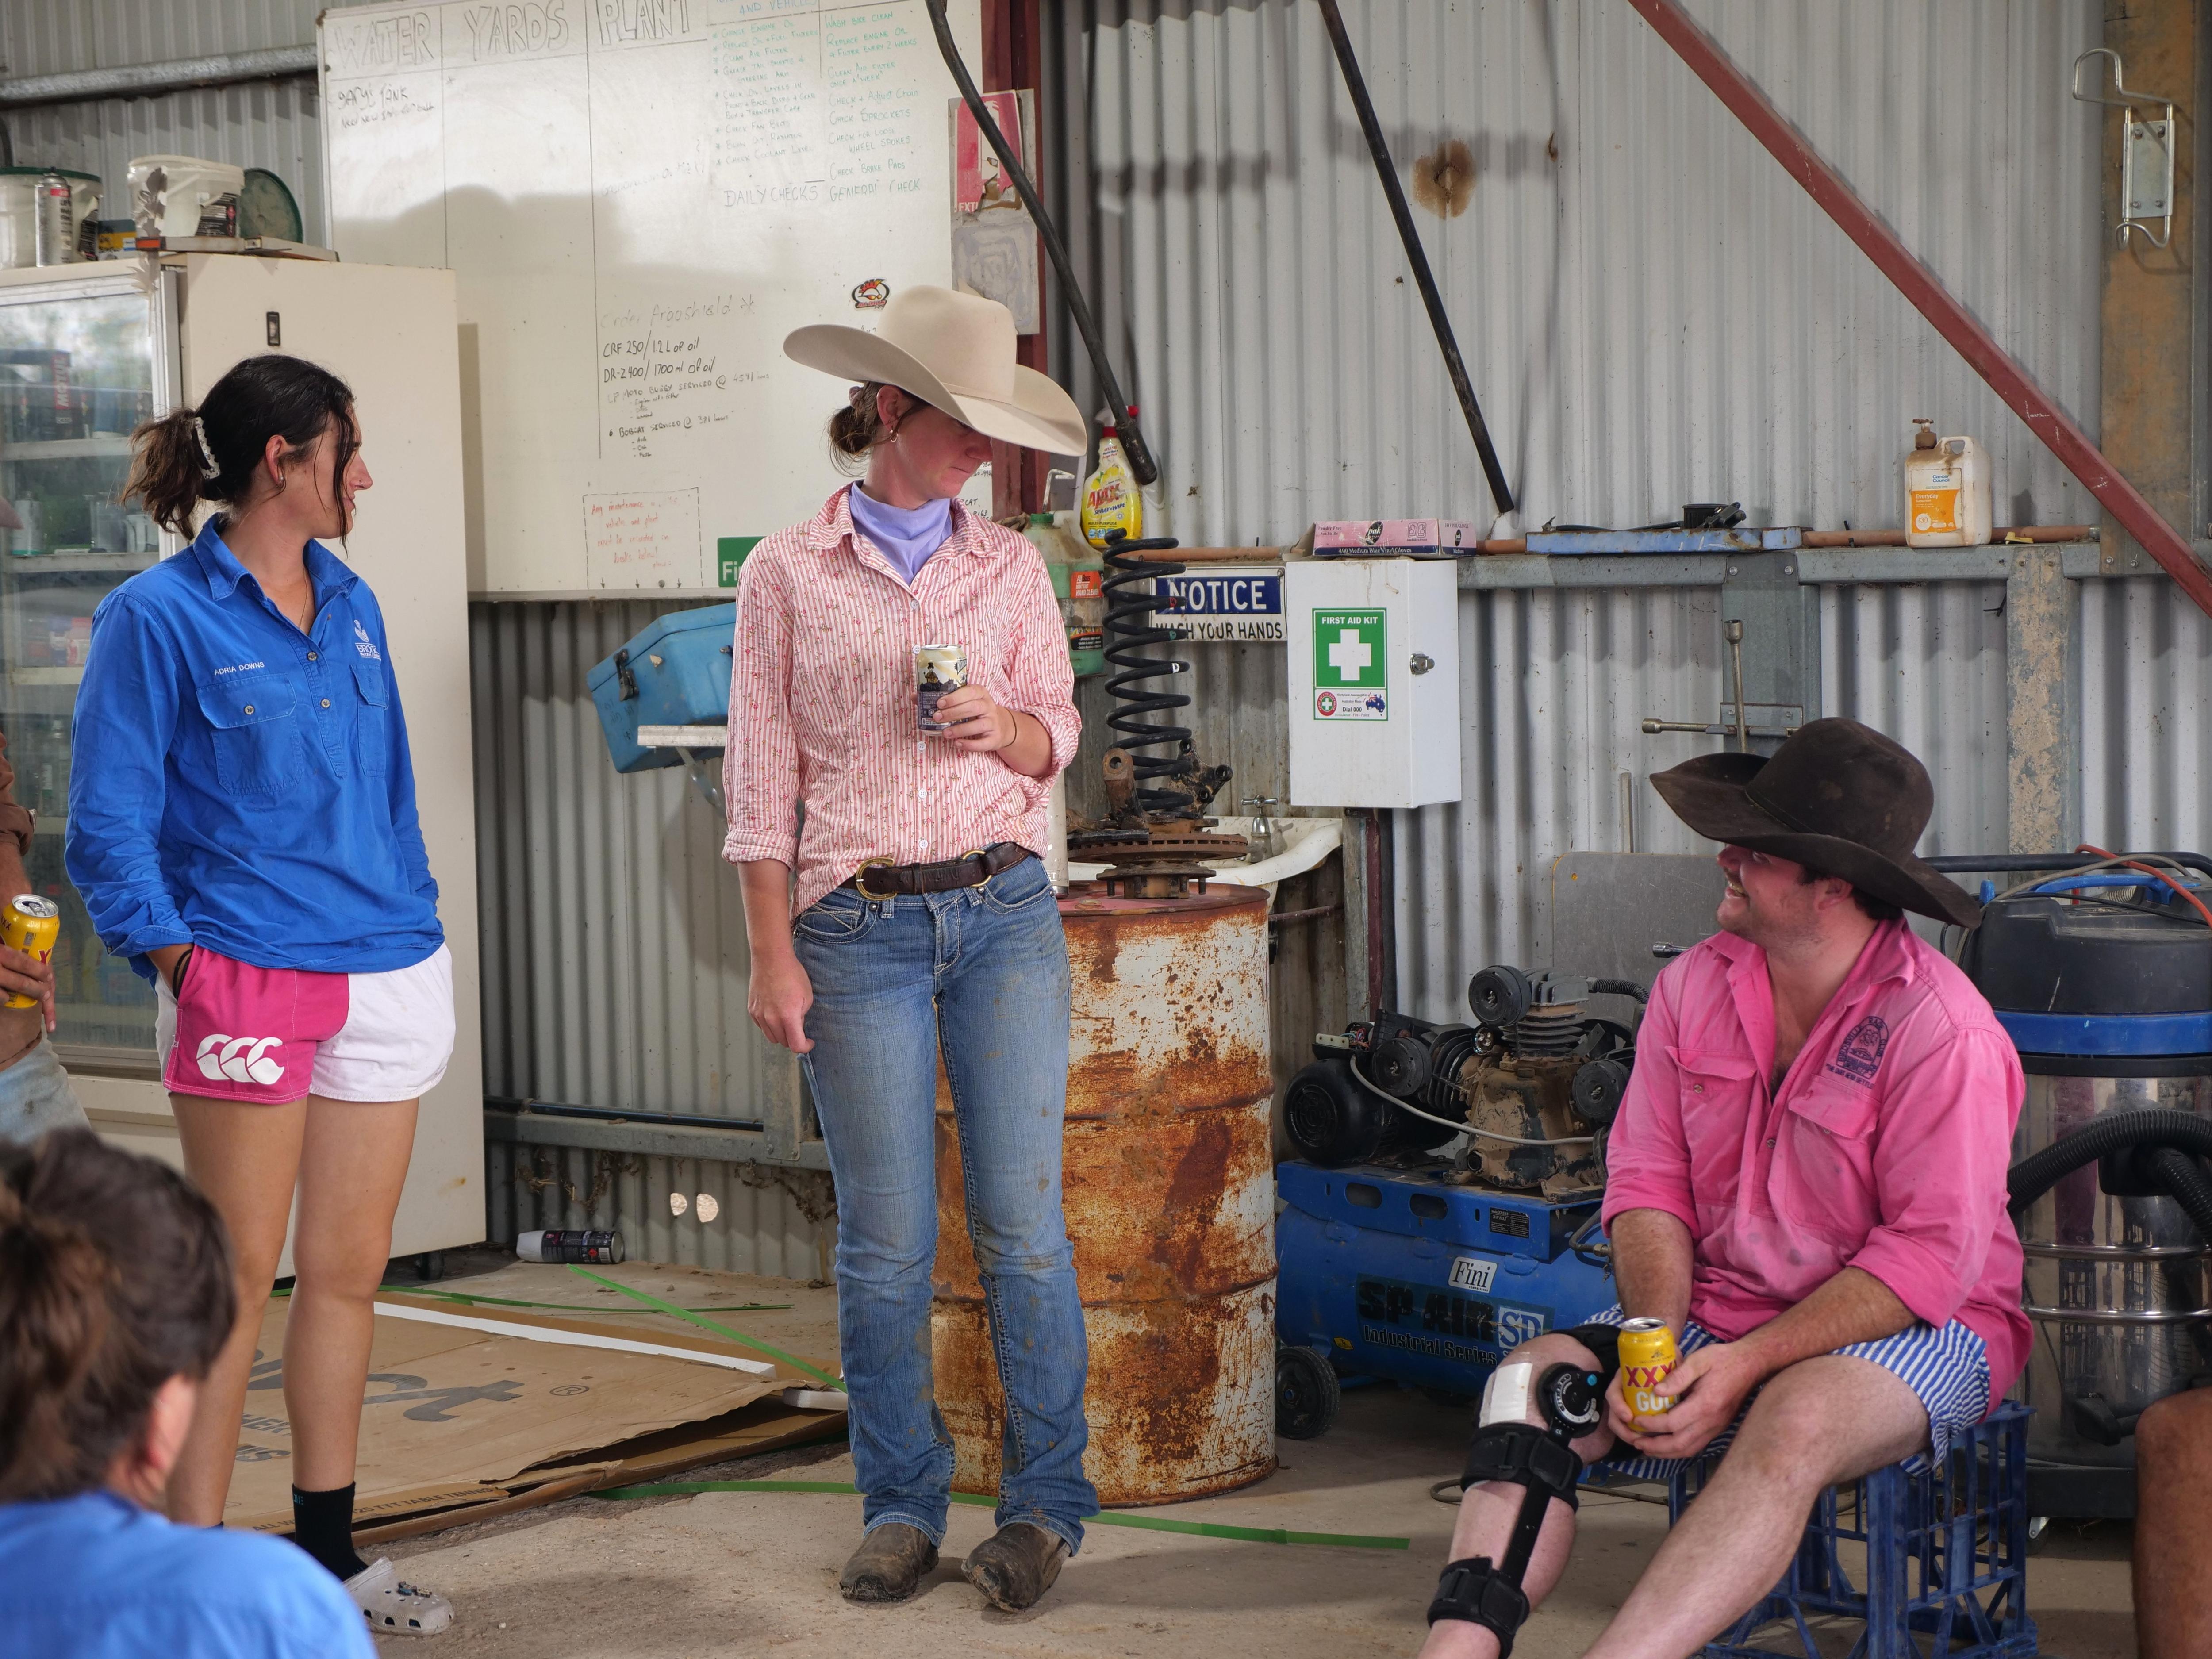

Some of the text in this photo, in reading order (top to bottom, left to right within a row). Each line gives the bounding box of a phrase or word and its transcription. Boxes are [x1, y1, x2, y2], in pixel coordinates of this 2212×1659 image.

[596, 0, 690, 45] PLANT
[751, 23, 776, 33] ENGINE
[825, 14, 845, 28] WASH
[872, 12, 893, 22] CLEAN
[464, 0, 569, 61] YARDS
[826, 33, 859, 47] REPLACE
[864, 31, 889, 41] ENGINE
[334, 12, 434, 69] WATER
[887, 41, 891, 50] 2
[895, 38, 917, 48] WEEKS
[828, 66, 852, 78] CLEAN
[872, 61, 896, 70] FILTER
[829, 88, 919, 107] CHECK Adjust Chain
[830, 108, 910, 125] CHECK SPROCKETS
[828, 132, 854, 144] CHECK
[849, 136, 910, 153] WHEEL SPOKES
[830, 158, 906, 180] CHECK BRAKE PADS
[724, 185, 818, 207] DAILY CHECKS
[603, 343, 622, 357] CRF
[655, 364, 673, 376] 1700
[679, 380, 712, 391] SERVICED
[1087, 481, 1120, 510] AJAX
[1169, 580, 1267, 611] NOTICE
[1198, 622, 1233, 639] YOUR
[1238, 622, 1283, 639] HANDS
[215, 661, 265, 676] ADRIA DOWNS
[1452, 1260, 1490, 1288] Fini
[1358, 1281, 1413, 1324] SP
[1422, 1292, 1494, 1342] AIR
[1363, 1324, 1498, 1367] Industrial Series
[401, 1494, 445, 1505] TABLE
[443, 1487, 494, 1498] TENNIS
